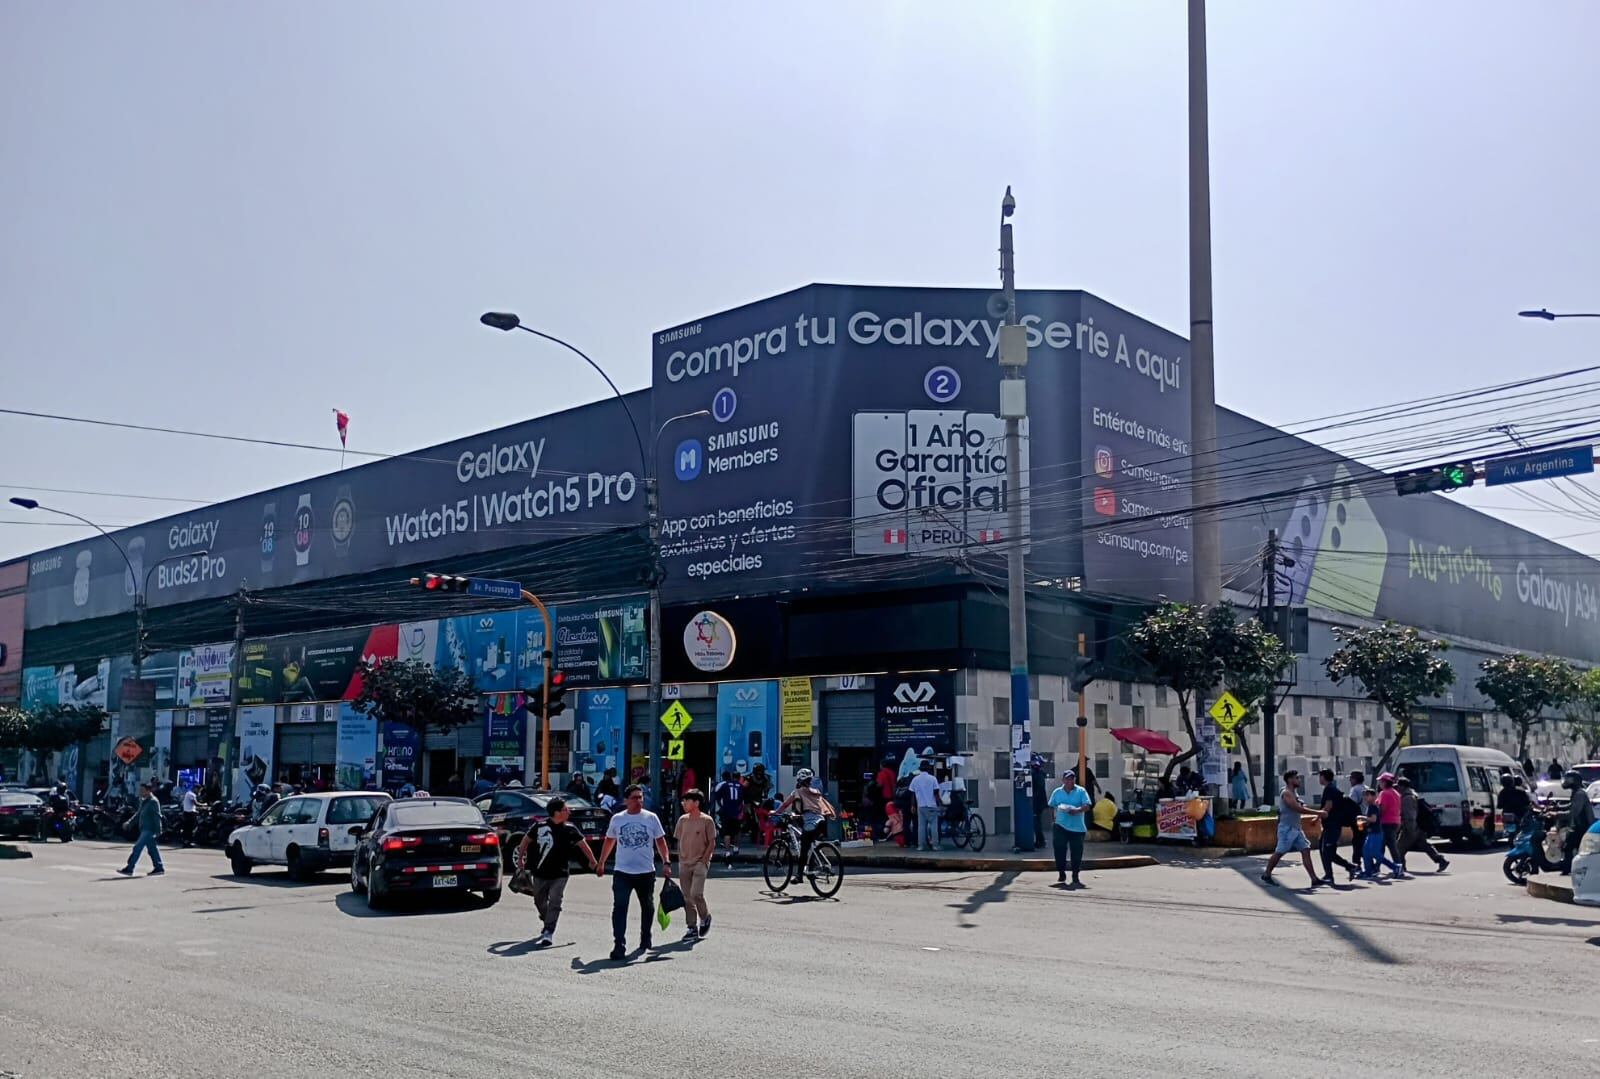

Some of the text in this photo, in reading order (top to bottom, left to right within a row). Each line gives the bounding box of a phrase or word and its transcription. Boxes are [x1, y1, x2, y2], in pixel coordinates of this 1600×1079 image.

[659, 323, 702, 345] SAMSUNG
[666, 311, 1181, 393] Compra tu Galaxy Serie A aquí
[936, 375, 949, 393] 2
[708, 421, 779, 451] SAMSUNG
[908, 423, 985, 448] 1 Año
[1093, 407, 1145, 440] Entérate
[1147, 428, 1171, 450] más
[456, 437, 546, 483] Galaxy
[708, 447, 779, 475] Members
[875, 448, 1008, 473] Garantía
[1503, 457, 1574, 477] Av. Argentina
[385, 500, 469, 546] Watch5
[482, 476, 580, 527] Watch5
[587, 471, 636, 508] Pro
[876, 475, 1008, 513] Oficial
[168, 519, 220, 550] Galaxy
[661, 499, 794, 538] App con beneficios
[660, 525, 796, 558] exclusivos y ofertas
[1098, 532, 1188, 566] samsung.com/pe
[31, 556, 63, 575] SAMSUNG
[158, 556, 226, 589] Buds2 Pro
[687, 554, 762, 580] especiales
[1516, 561, 1570, 627] Galaxy
